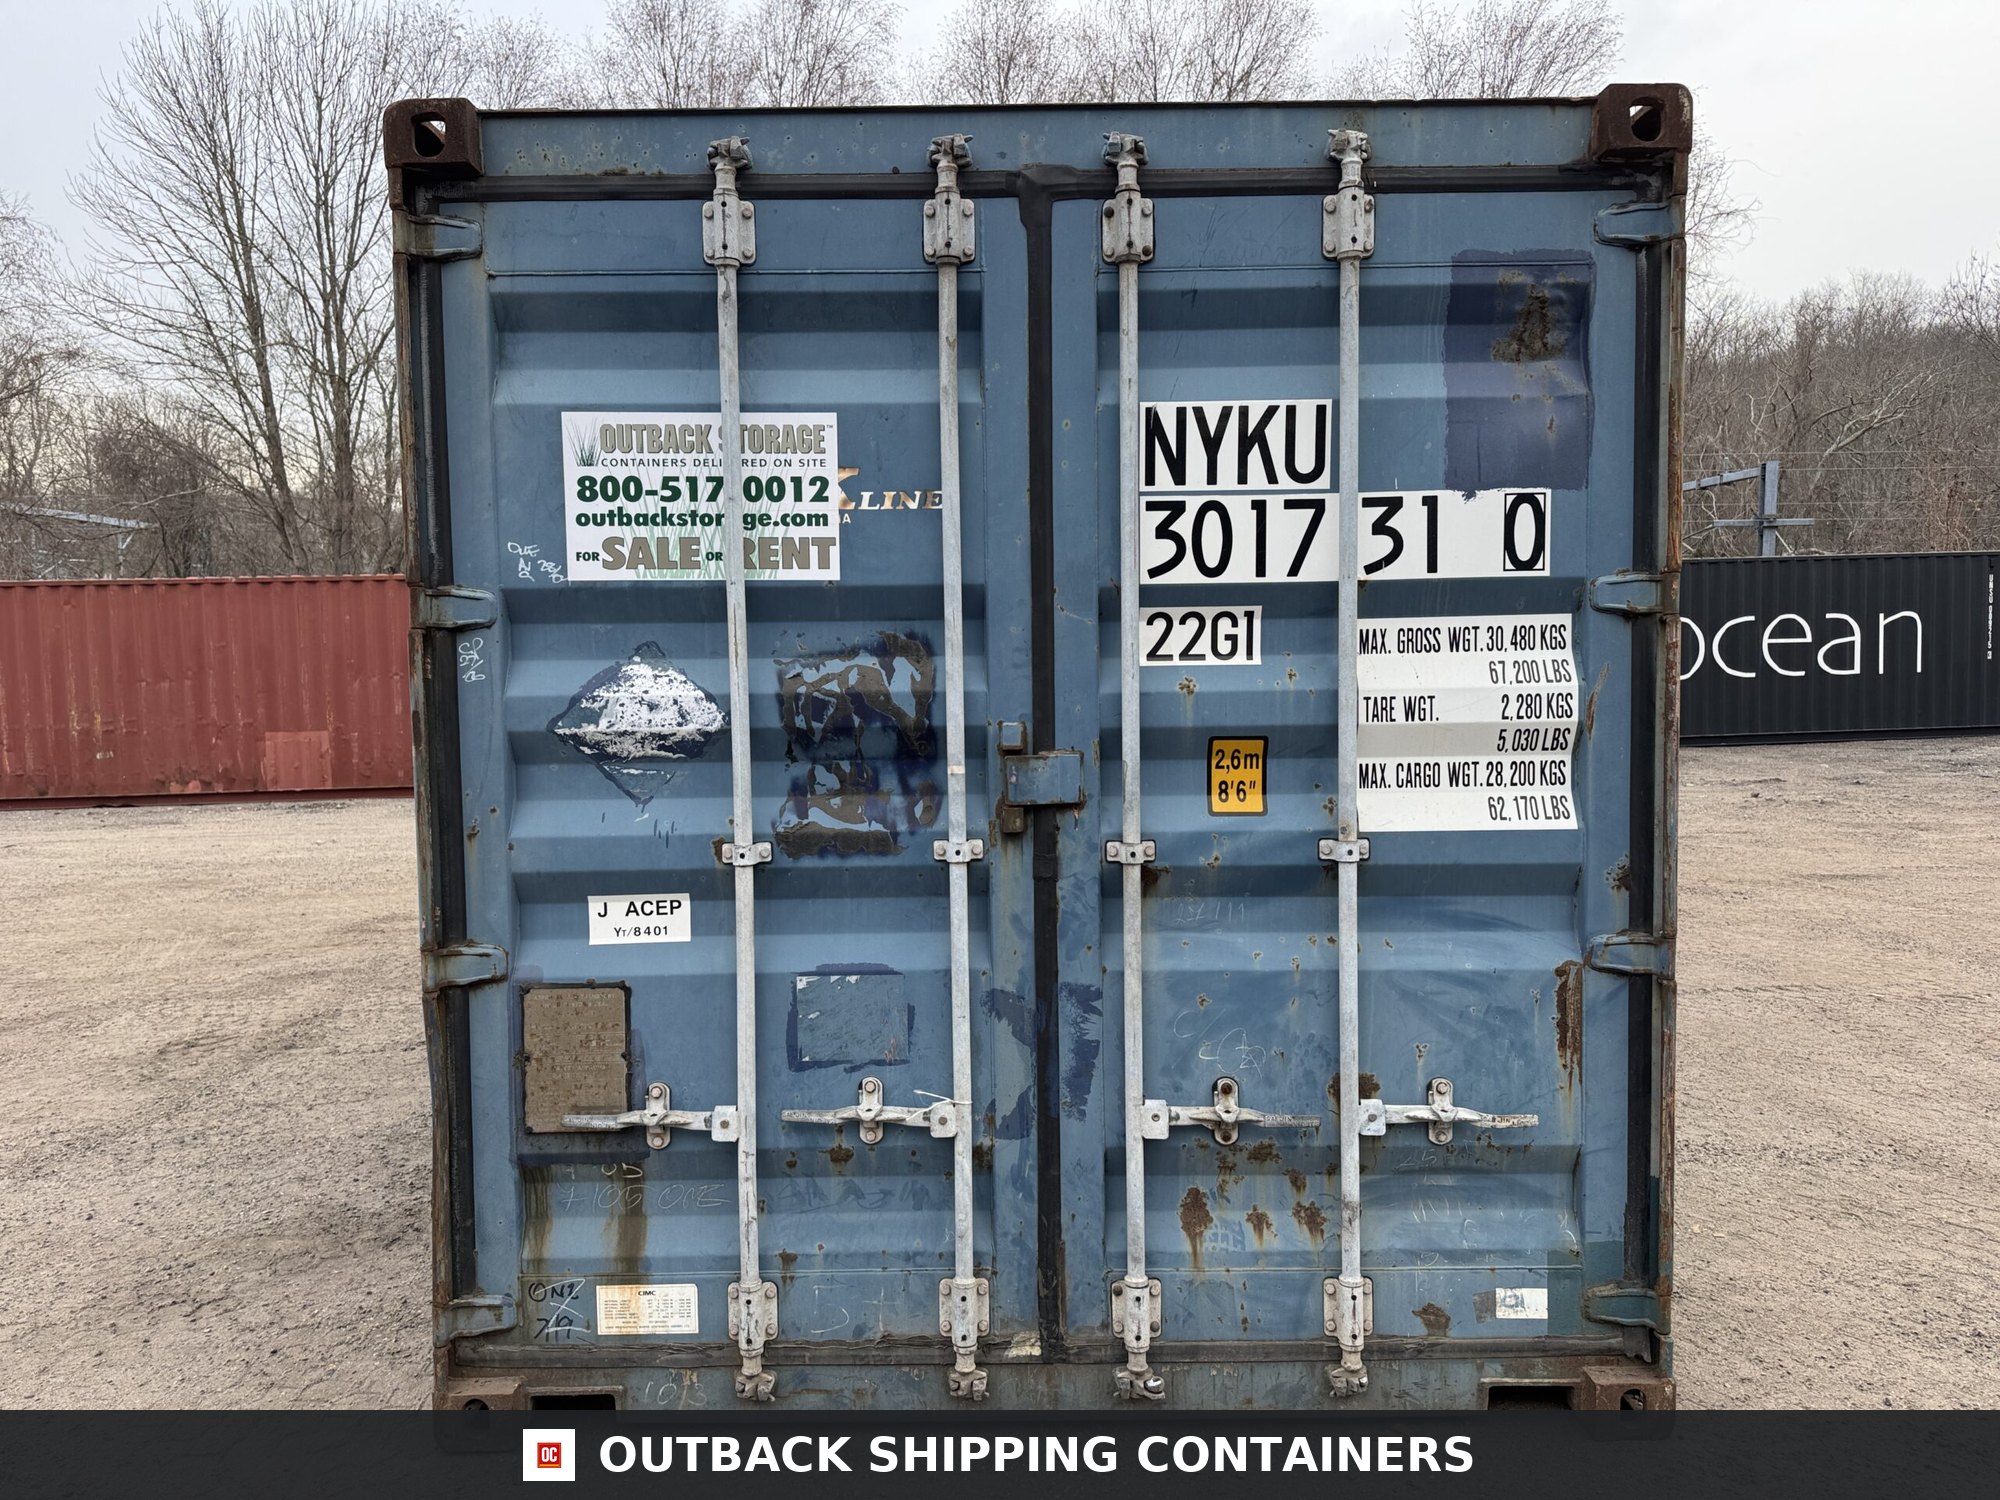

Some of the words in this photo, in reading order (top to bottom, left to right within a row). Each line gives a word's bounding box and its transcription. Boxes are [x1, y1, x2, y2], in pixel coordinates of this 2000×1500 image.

[600, 424, 713, 454] OUTBACK
[718, 424, 826, 454] TORAGE
[1145, 404, 1326, 487] NYKU
[601, 458, 687, 467] CONTAINERS
[693, 458, 767, 467] DELIRED
[773, 459, 792, 467] ON
[798, 459, 826, 467] SITE
[577, 475, 830, 503] 800-5170012
[576, 506, 829, 531] outbackstorge.com
[1503, 492, 1546, 572] 0
[575, 551, 600, 562] FOR
[601, 536, 701, 571] SALE
[705, 551, 723, 562] OR
[743, 537, 836, 570] RENT
[1147, 611, 1254, 662] 22G1
[1359, 628, 1392, 655] MAX.
[1397, 627, 1442, 654] GROSS
[1448, 626, 1484, 653] WGT.
[1486, 625, 1536, 653] 30,480
[1540, 624, 1567, 651] KGS
[1488, 660, 1541, 685] 67,200
[1543, 659, 1572, 683] LBS
[1363, 696, 1396, 723] TARE
[1403, 695, 1439, 722] WGT.
[1501, 694, 1542, 721] 2,280
[1546, 692, 1573, 719] KGS
[1496, 728, 1540, 753] 5,030
[1541, 728, 1570, 751] LBS
[1359, 763, 1391, 789] MAX.
[1396, 762, 1441, 788] CARGO
[1447, 761, 1483, 788] WGT.
[1486, 761, 1536, 787] 28,200
[1540, 760, 1566, 786] KGS
[1487, 796, 1540, 821] 62,170
[1541, 795, 1570, 820] LBS
[597, 901, 608, 918] J
[625, 899, 682, 917] ACEP
